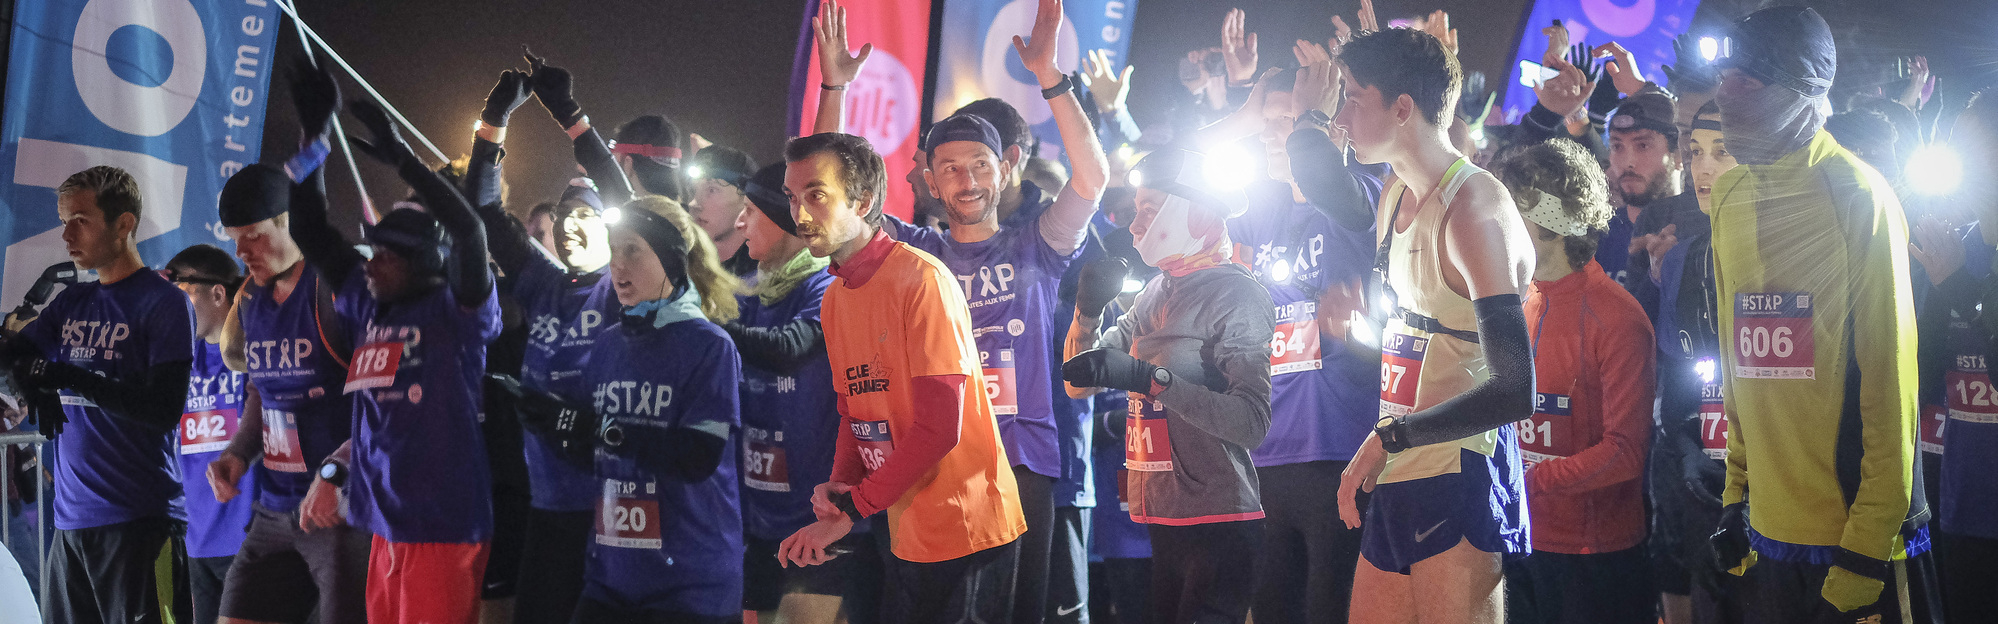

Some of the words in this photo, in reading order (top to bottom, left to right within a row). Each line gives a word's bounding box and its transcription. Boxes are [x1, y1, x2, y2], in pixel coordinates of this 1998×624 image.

[1740, 326, 1794, 358] 606
[356, 347, 390, 375] 178
[185, 414, 227, 441] 842
[1127, 425, 1154, 454] 281
